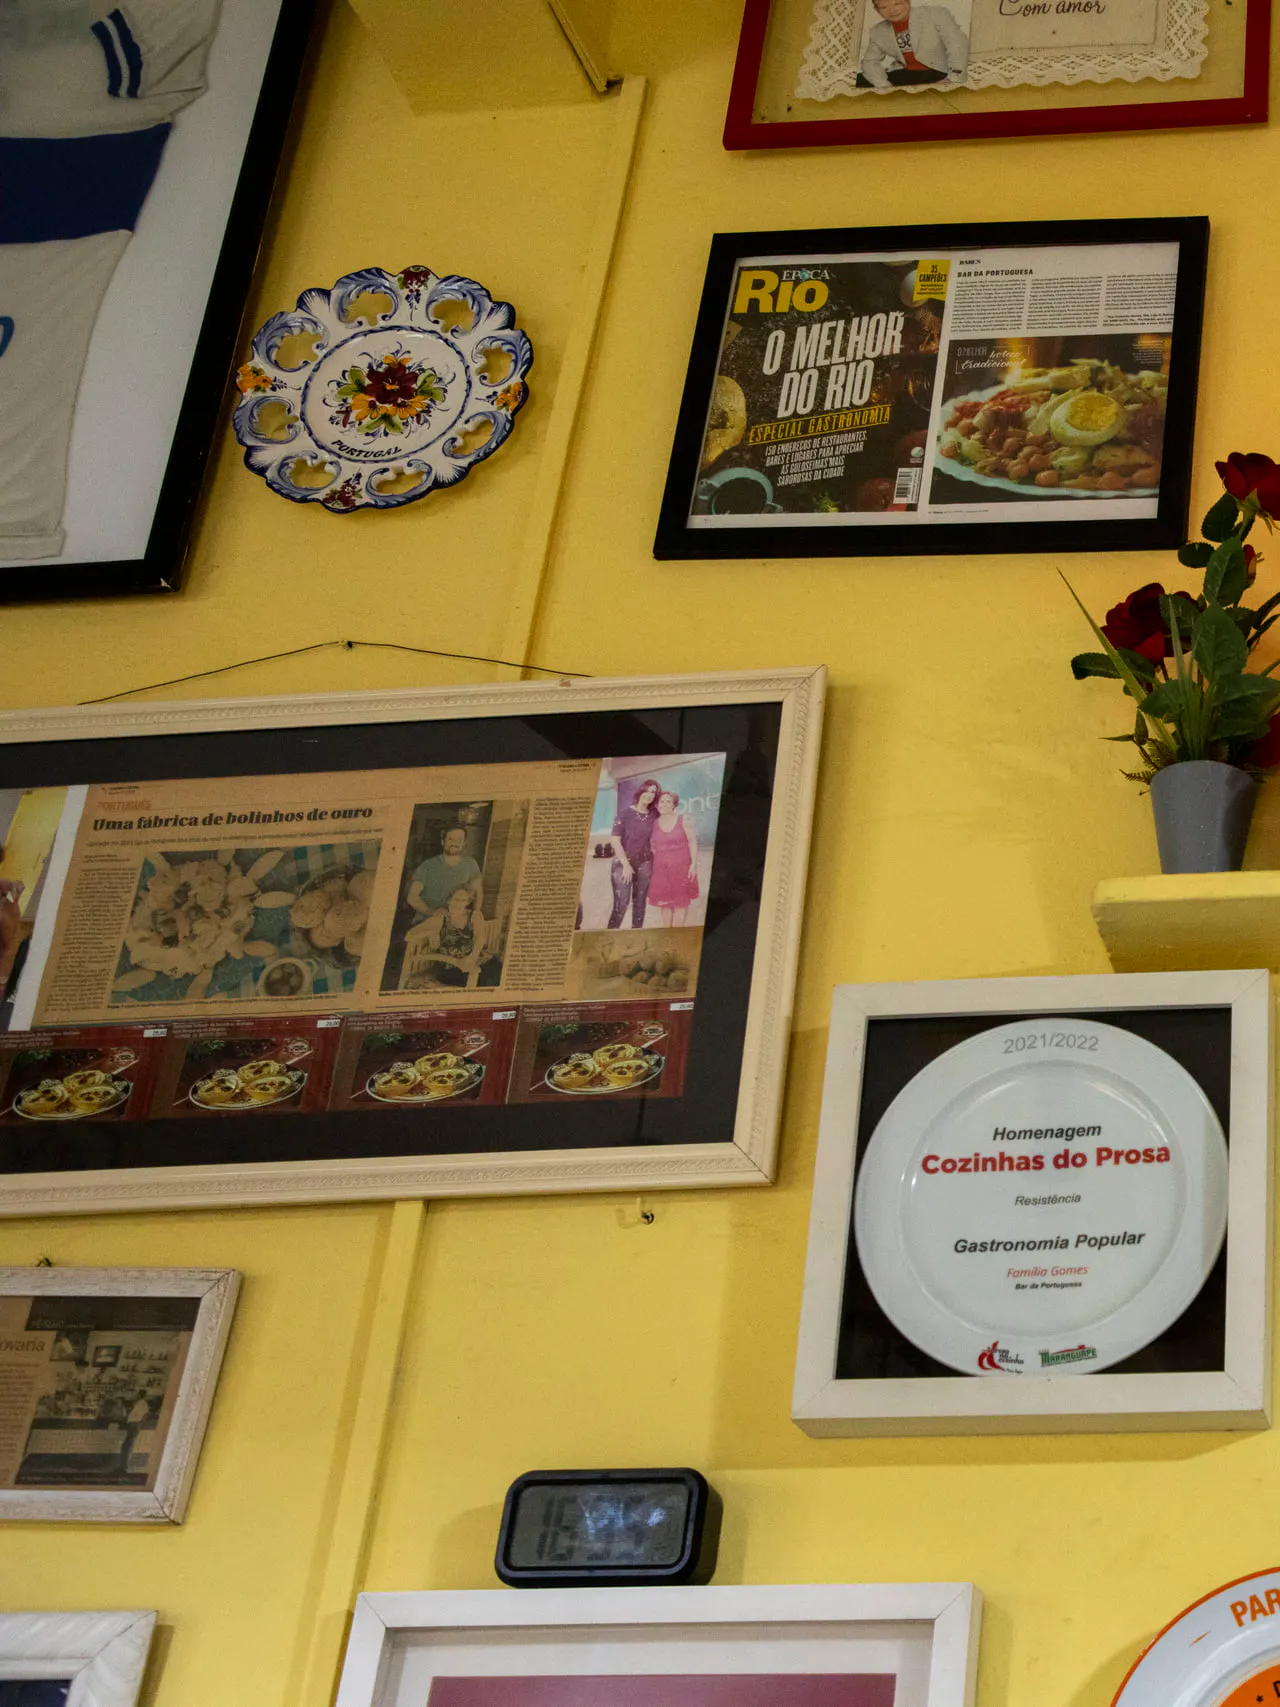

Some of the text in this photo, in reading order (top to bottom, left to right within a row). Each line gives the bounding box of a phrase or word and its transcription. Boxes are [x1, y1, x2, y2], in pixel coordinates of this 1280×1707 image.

[985, 268, 1034, 277] PORTUGUESA
[733, 270, 829, 314] Rio
[763, 311, 906, 376] O MELHOR
[777, 359, 875, 418] DO RIO
[749, 406, 891, 443] ESPECIAL GASTRONOMIA
[331, 439, 402, 459] PORTUGAL
[812, 438, 822, 448] DE
[818, 447, 834, 458] PARA
[835, 442, 864, 456] APRECIAR
[780, 464, 789, 475] AS
[828, 456, 845, 467] MAIS
[813, 470, 822, 481] DA
[823, 467, 845, 479] CIDADE
[93, 807, 373, 832] Uma fábrica de bolinhos de ouro
[1002, 1032, 1100, 1054] 2021/2022
[992, 1124, 1102, 1142] Homenagem
[921, 1146, 1171, 1174] Cozinhas do Prosa
[1014, 1193, 1082, 1206] Resistência
[953, 1231, 1146, 1254] Gastronomia Popular
[1050, 1264, 1089, 1277] Gomes
[1015, 1280, 1082, 1290] Bar da Portuguesa
